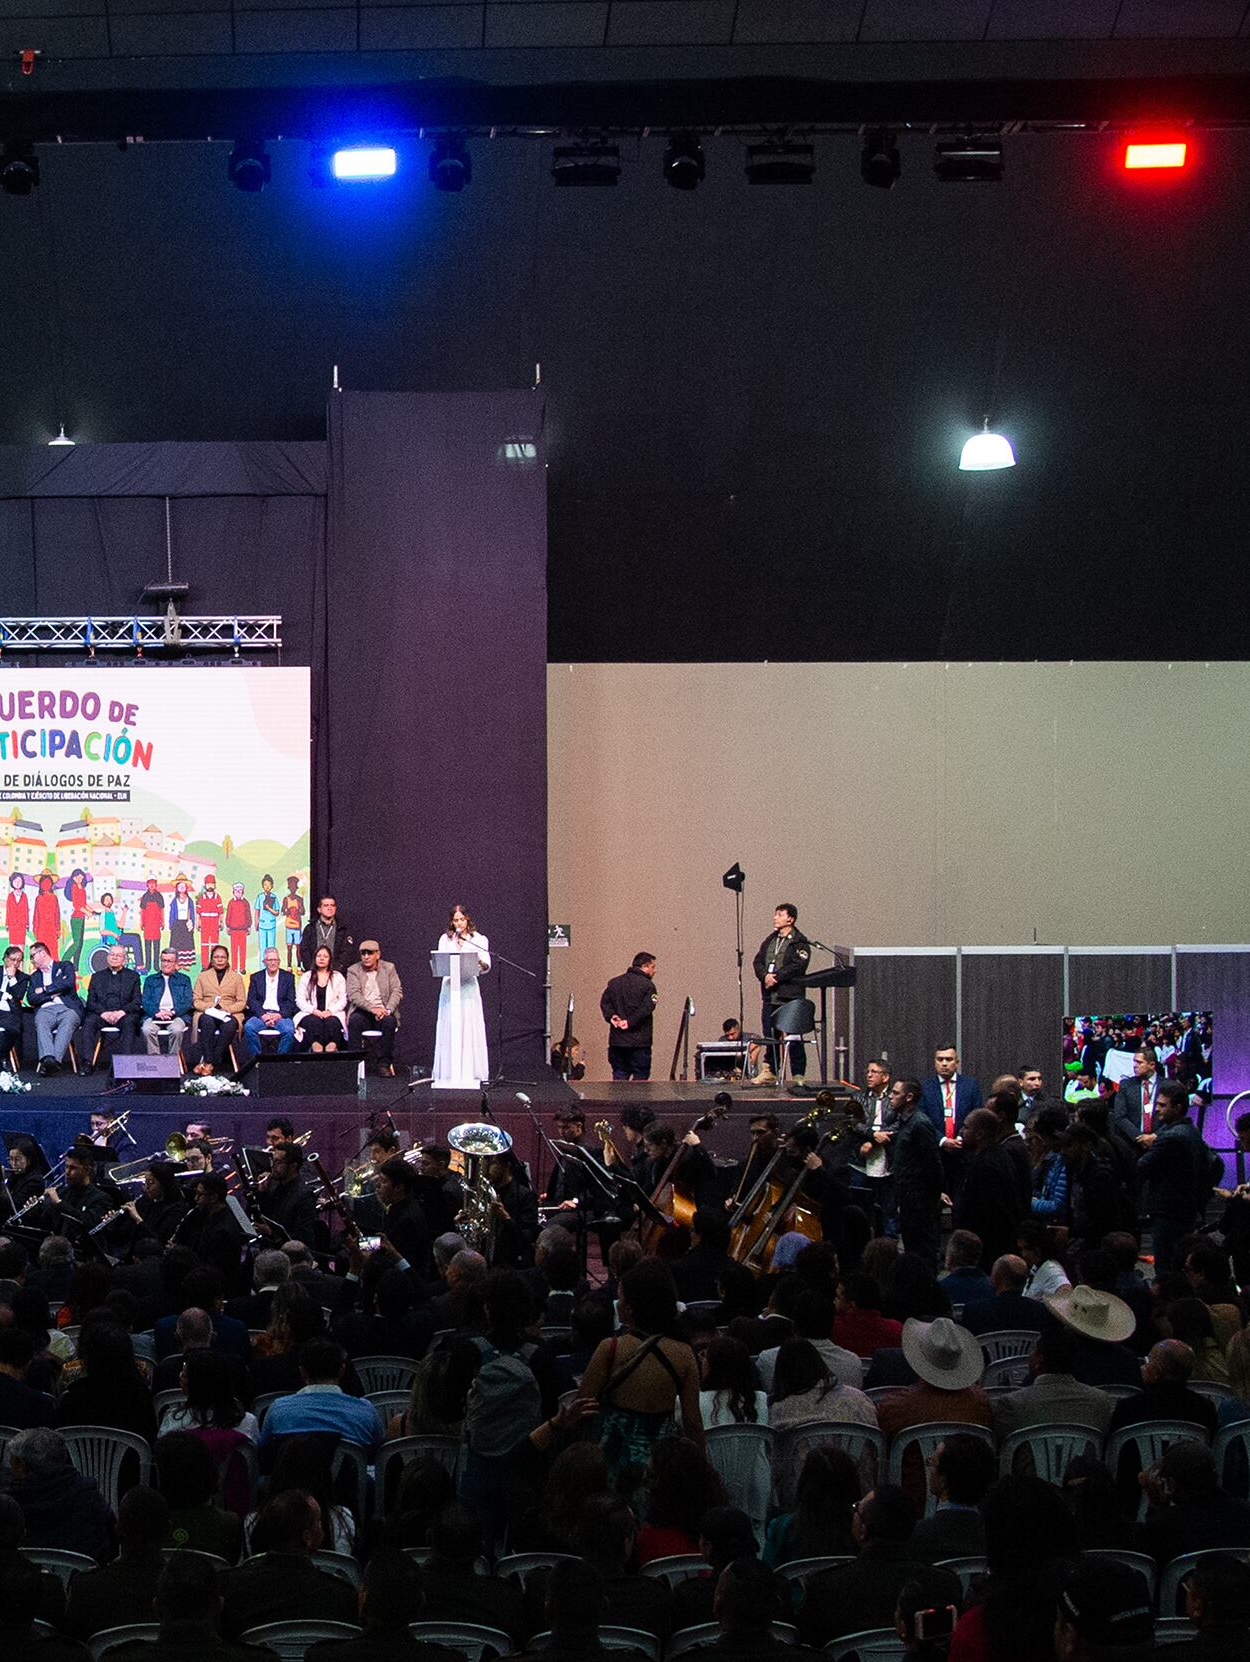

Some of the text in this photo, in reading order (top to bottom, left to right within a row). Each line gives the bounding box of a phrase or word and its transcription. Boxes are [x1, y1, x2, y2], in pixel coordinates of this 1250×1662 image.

[108, 700, 139, 726] DE
[4, 774, 19, 787] DE
[24, 771, 83, 787] DIÁLOGOS
[87, 774, 103, 787] DE
[107, 774, 130, 787] PAZ
[2, 792, 26, 800] COLOMBIA
[54, 792, 60, 800] DE
